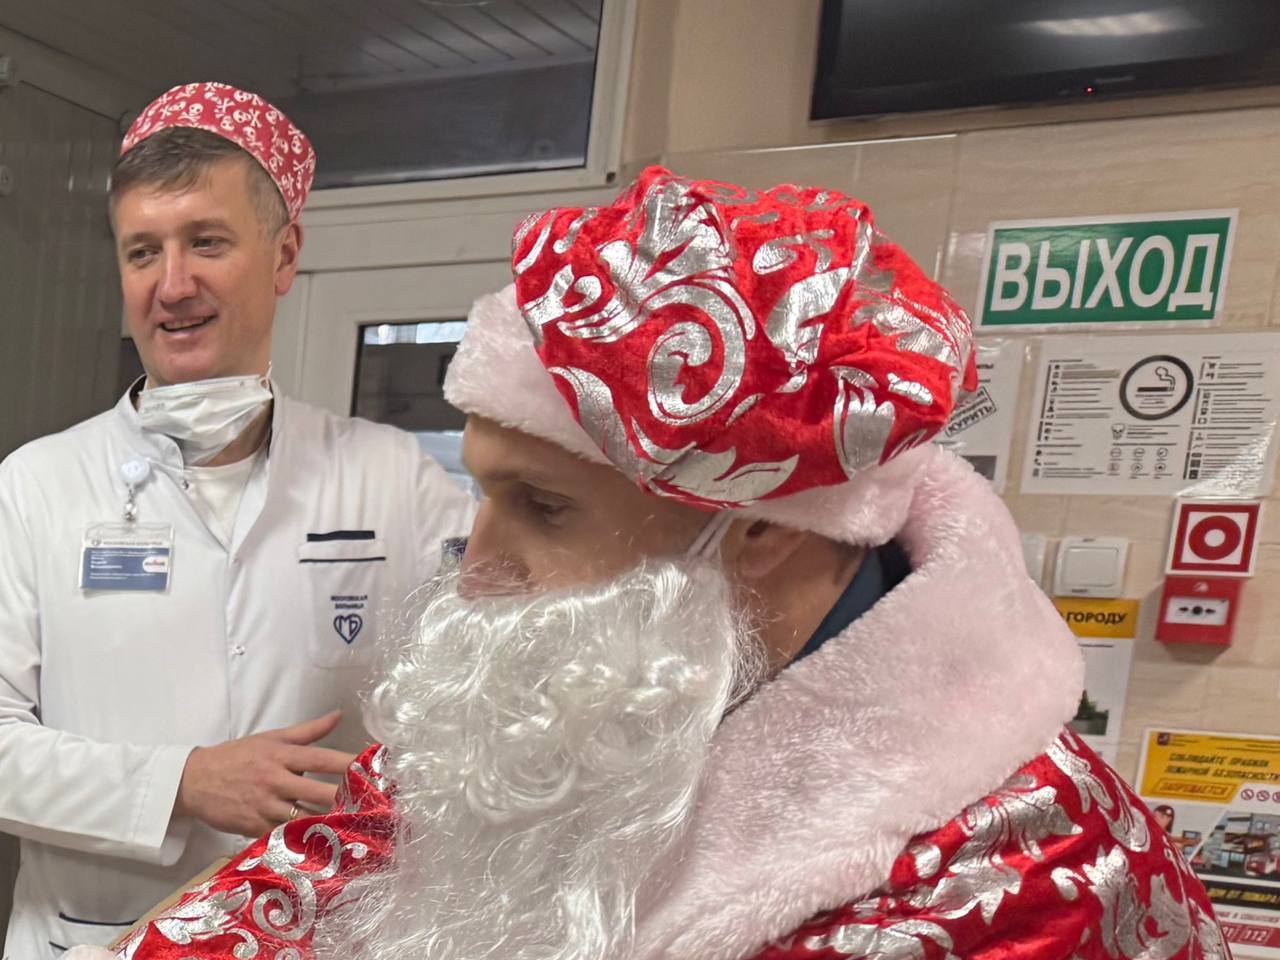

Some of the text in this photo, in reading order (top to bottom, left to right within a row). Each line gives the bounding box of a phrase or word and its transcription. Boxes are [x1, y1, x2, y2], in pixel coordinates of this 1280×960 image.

[990, 233, 1220, 312] ВЫХОД
[947, 405, 993, 432] КУРИТЬ
[1066, 611, 1128, 625] ГОРОДУ
